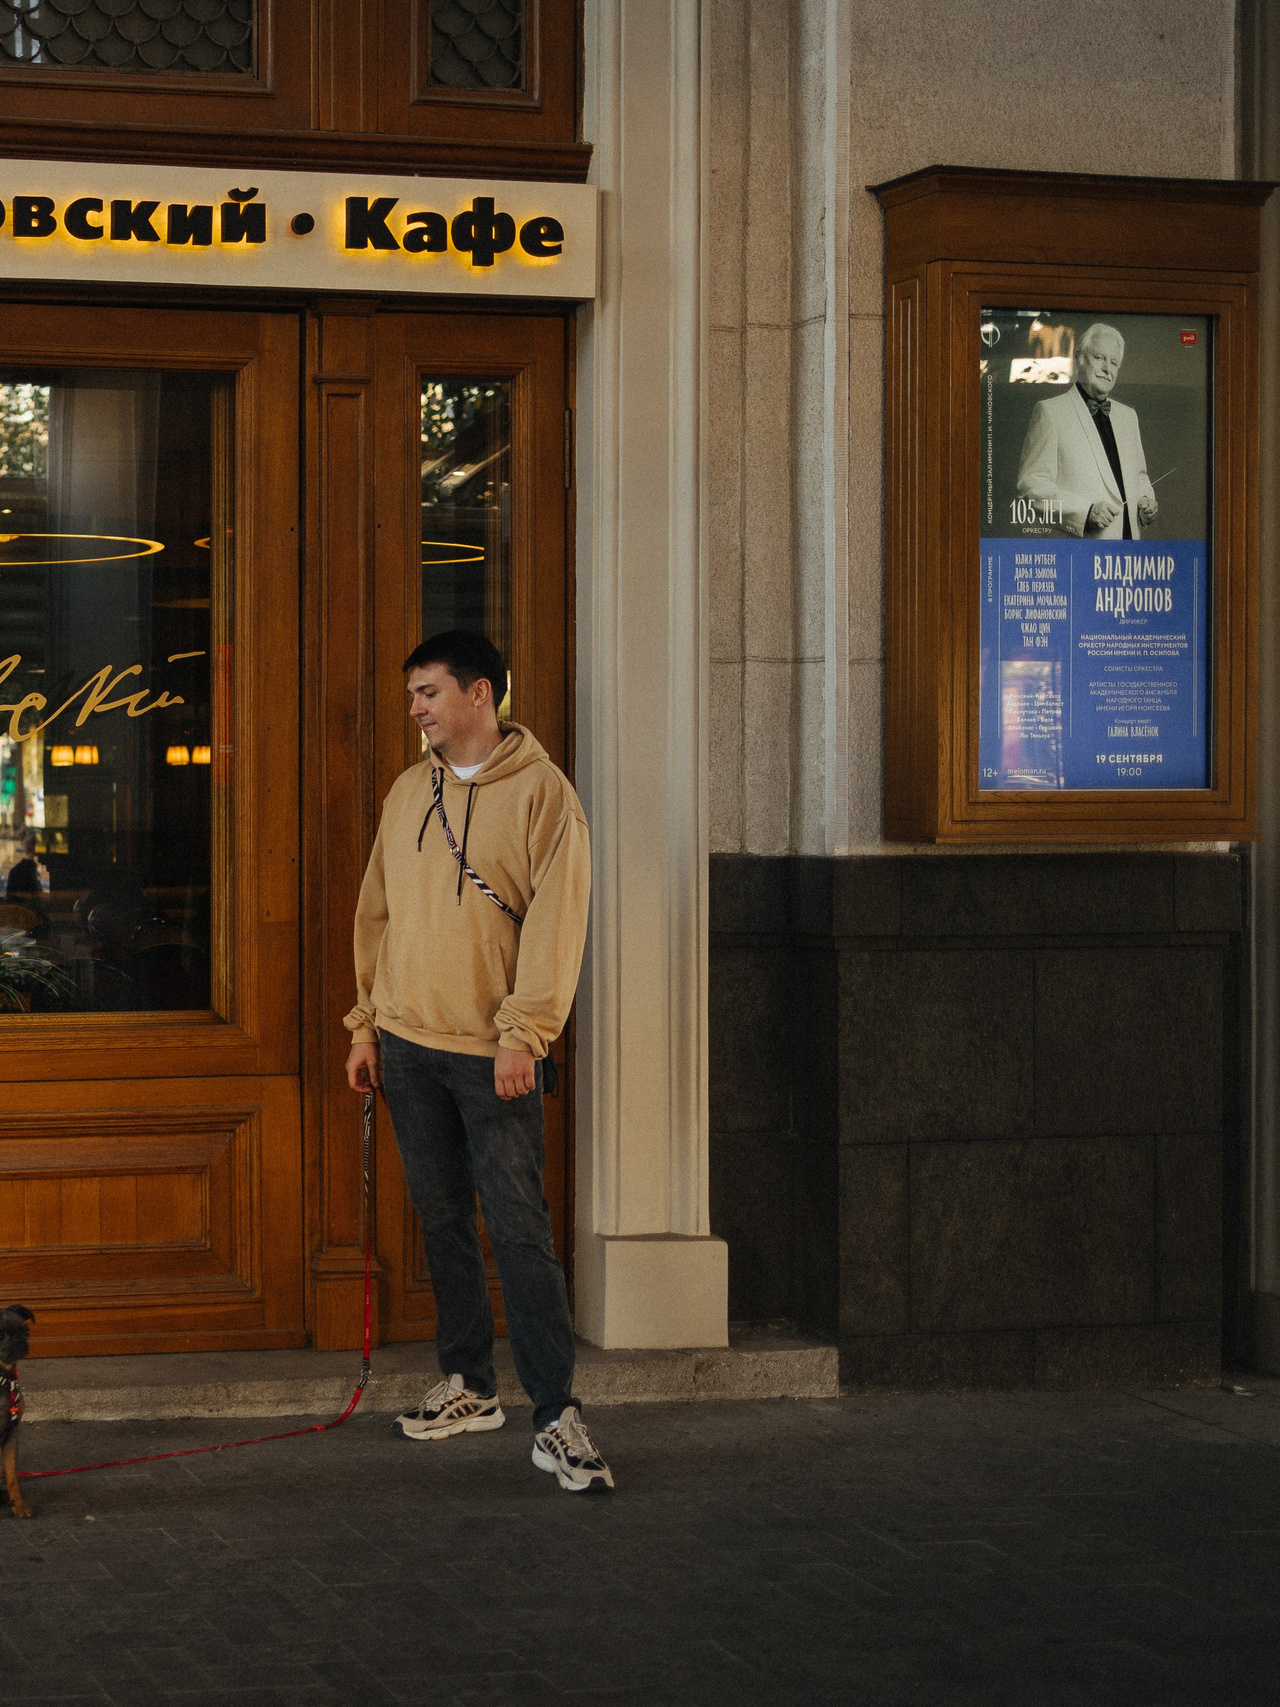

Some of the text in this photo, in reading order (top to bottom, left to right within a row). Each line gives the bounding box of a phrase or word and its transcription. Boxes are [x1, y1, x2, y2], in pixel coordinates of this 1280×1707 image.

[346, 196, 565, 266] Кафе
[1010, 499, 1063, 525] 105 ЛЕТ
[1015, 554, 1056, 565] ЮЛИЯ РУТБЕРГ
[1014, 568, 1057, 581] ДАРЬЯ ЗЫКОВА
[1094, 555, 1175, 586] ВЛАДИМИР
[1017, 582, 1030, 592] ГЛЕБ
[1004, 595, 1067, 606] ЕКАТЕРИНА МОЧАЛОВА
[1095, 587, 1172, 618] АНДРОПОВ
[1004, 609, 1023, 619] БОРИС
[1021, 623, 1037, 633] ЧЖАО
[1023, 637, 1048, 647] ТАН ФЭН
[1081, 633, 1132, 641] НАЦИОНАЛЬНЫЙ
[1108, 727, 1128, 737] ГАЛИНА
[1096, 755, 1163, 763] 19 СЕНТЯБРЯ
[983, 768, 998, 777] 12+
[1117, 768, 1142, 776] 19:00
